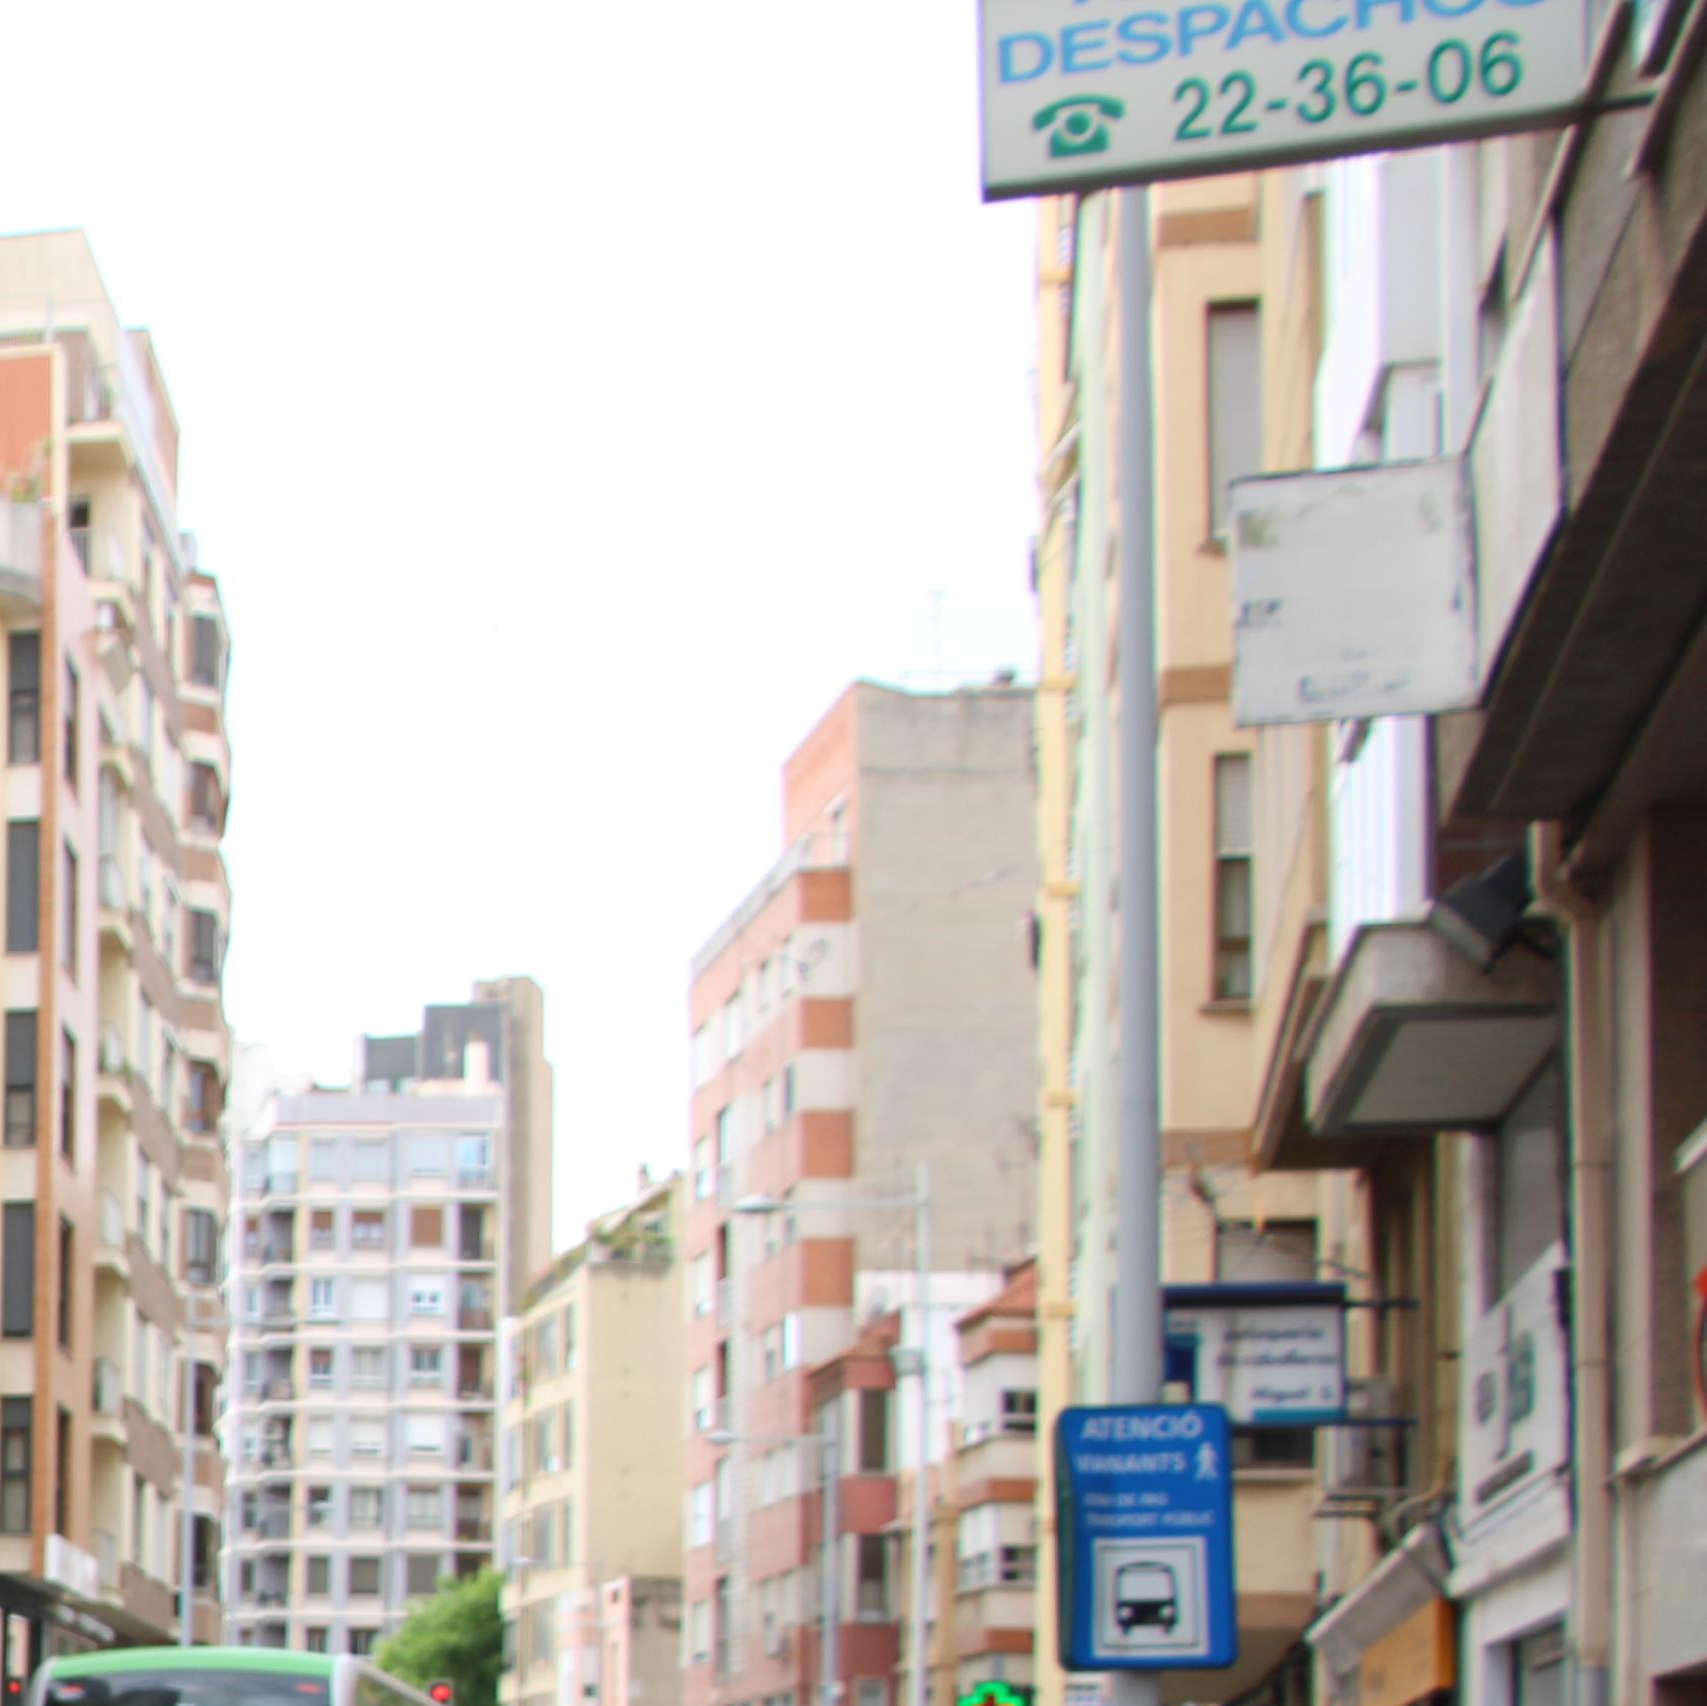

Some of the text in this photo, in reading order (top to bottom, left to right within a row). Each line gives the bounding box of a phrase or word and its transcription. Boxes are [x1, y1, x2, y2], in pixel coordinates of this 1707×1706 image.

[998, 0, 1545, 84] DESPACH
[1174, 31, 1523, 142] 22-36-06
[1081, 1410, 1204, 1441] ATENCIÓ
[1075, 1452, 1187, 1474] VIANANTS
